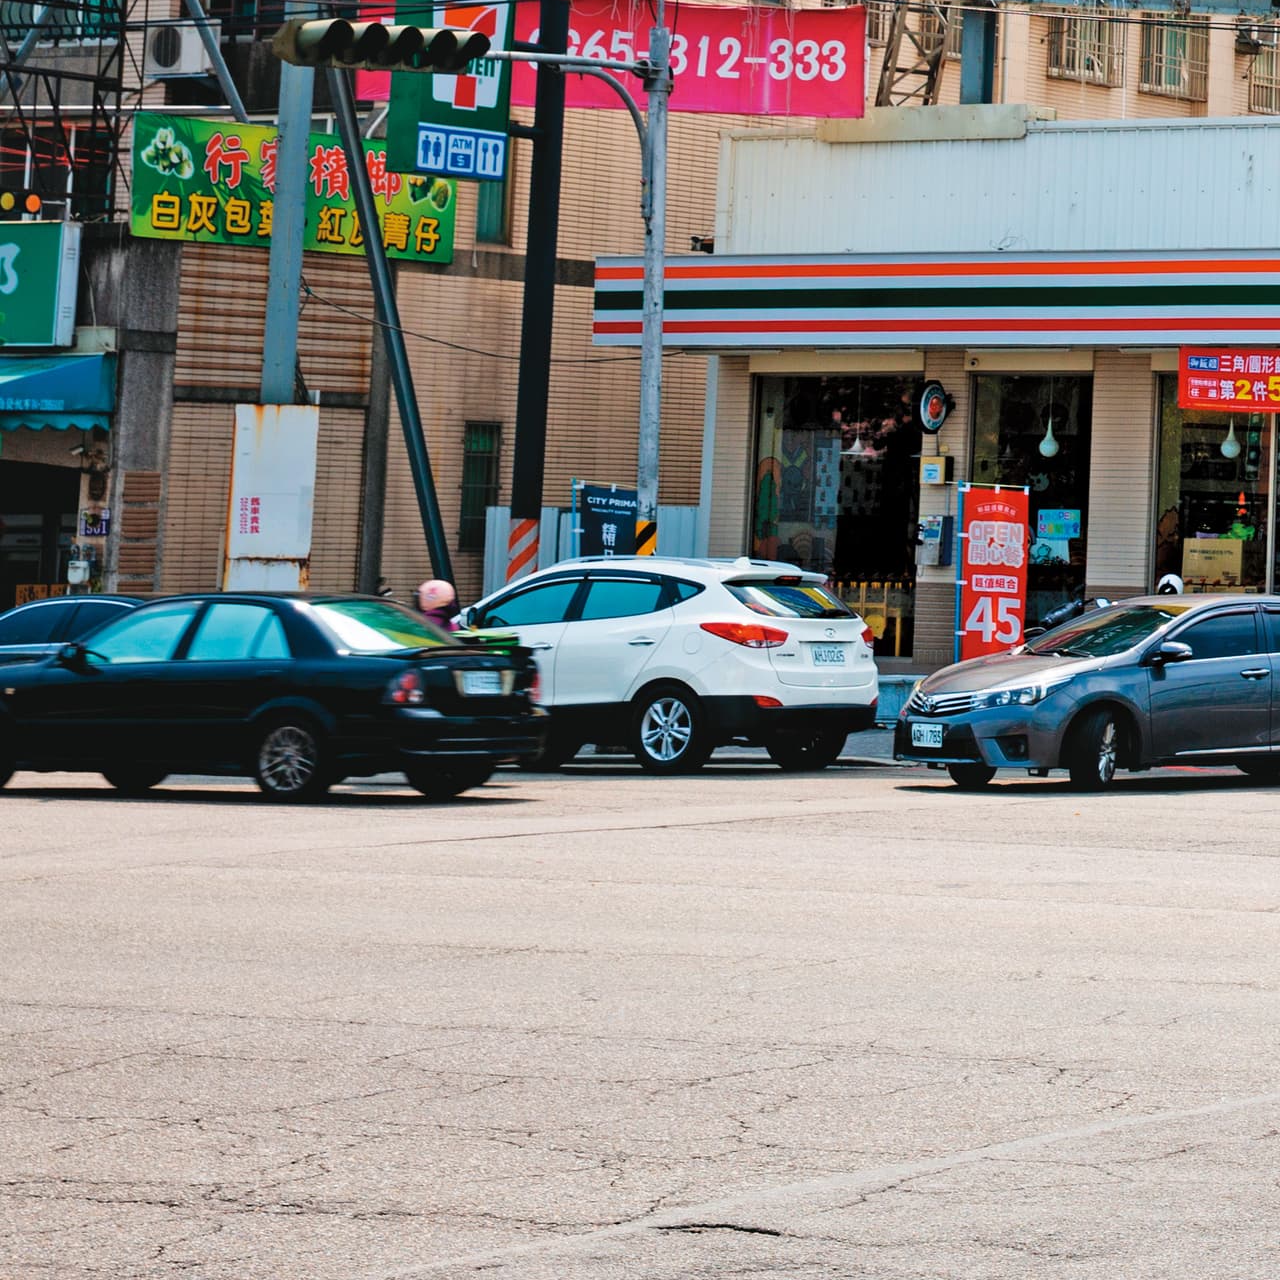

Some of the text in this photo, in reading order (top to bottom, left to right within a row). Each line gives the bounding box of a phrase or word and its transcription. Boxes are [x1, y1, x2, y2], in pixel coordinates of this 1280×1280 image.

[452, 138, 473, 150] ATM
[587, 496, 637, 507] CITY PRIMA
[971, 523, 1022, 543] OPEN
[965, 596, 1021, 644] 45
